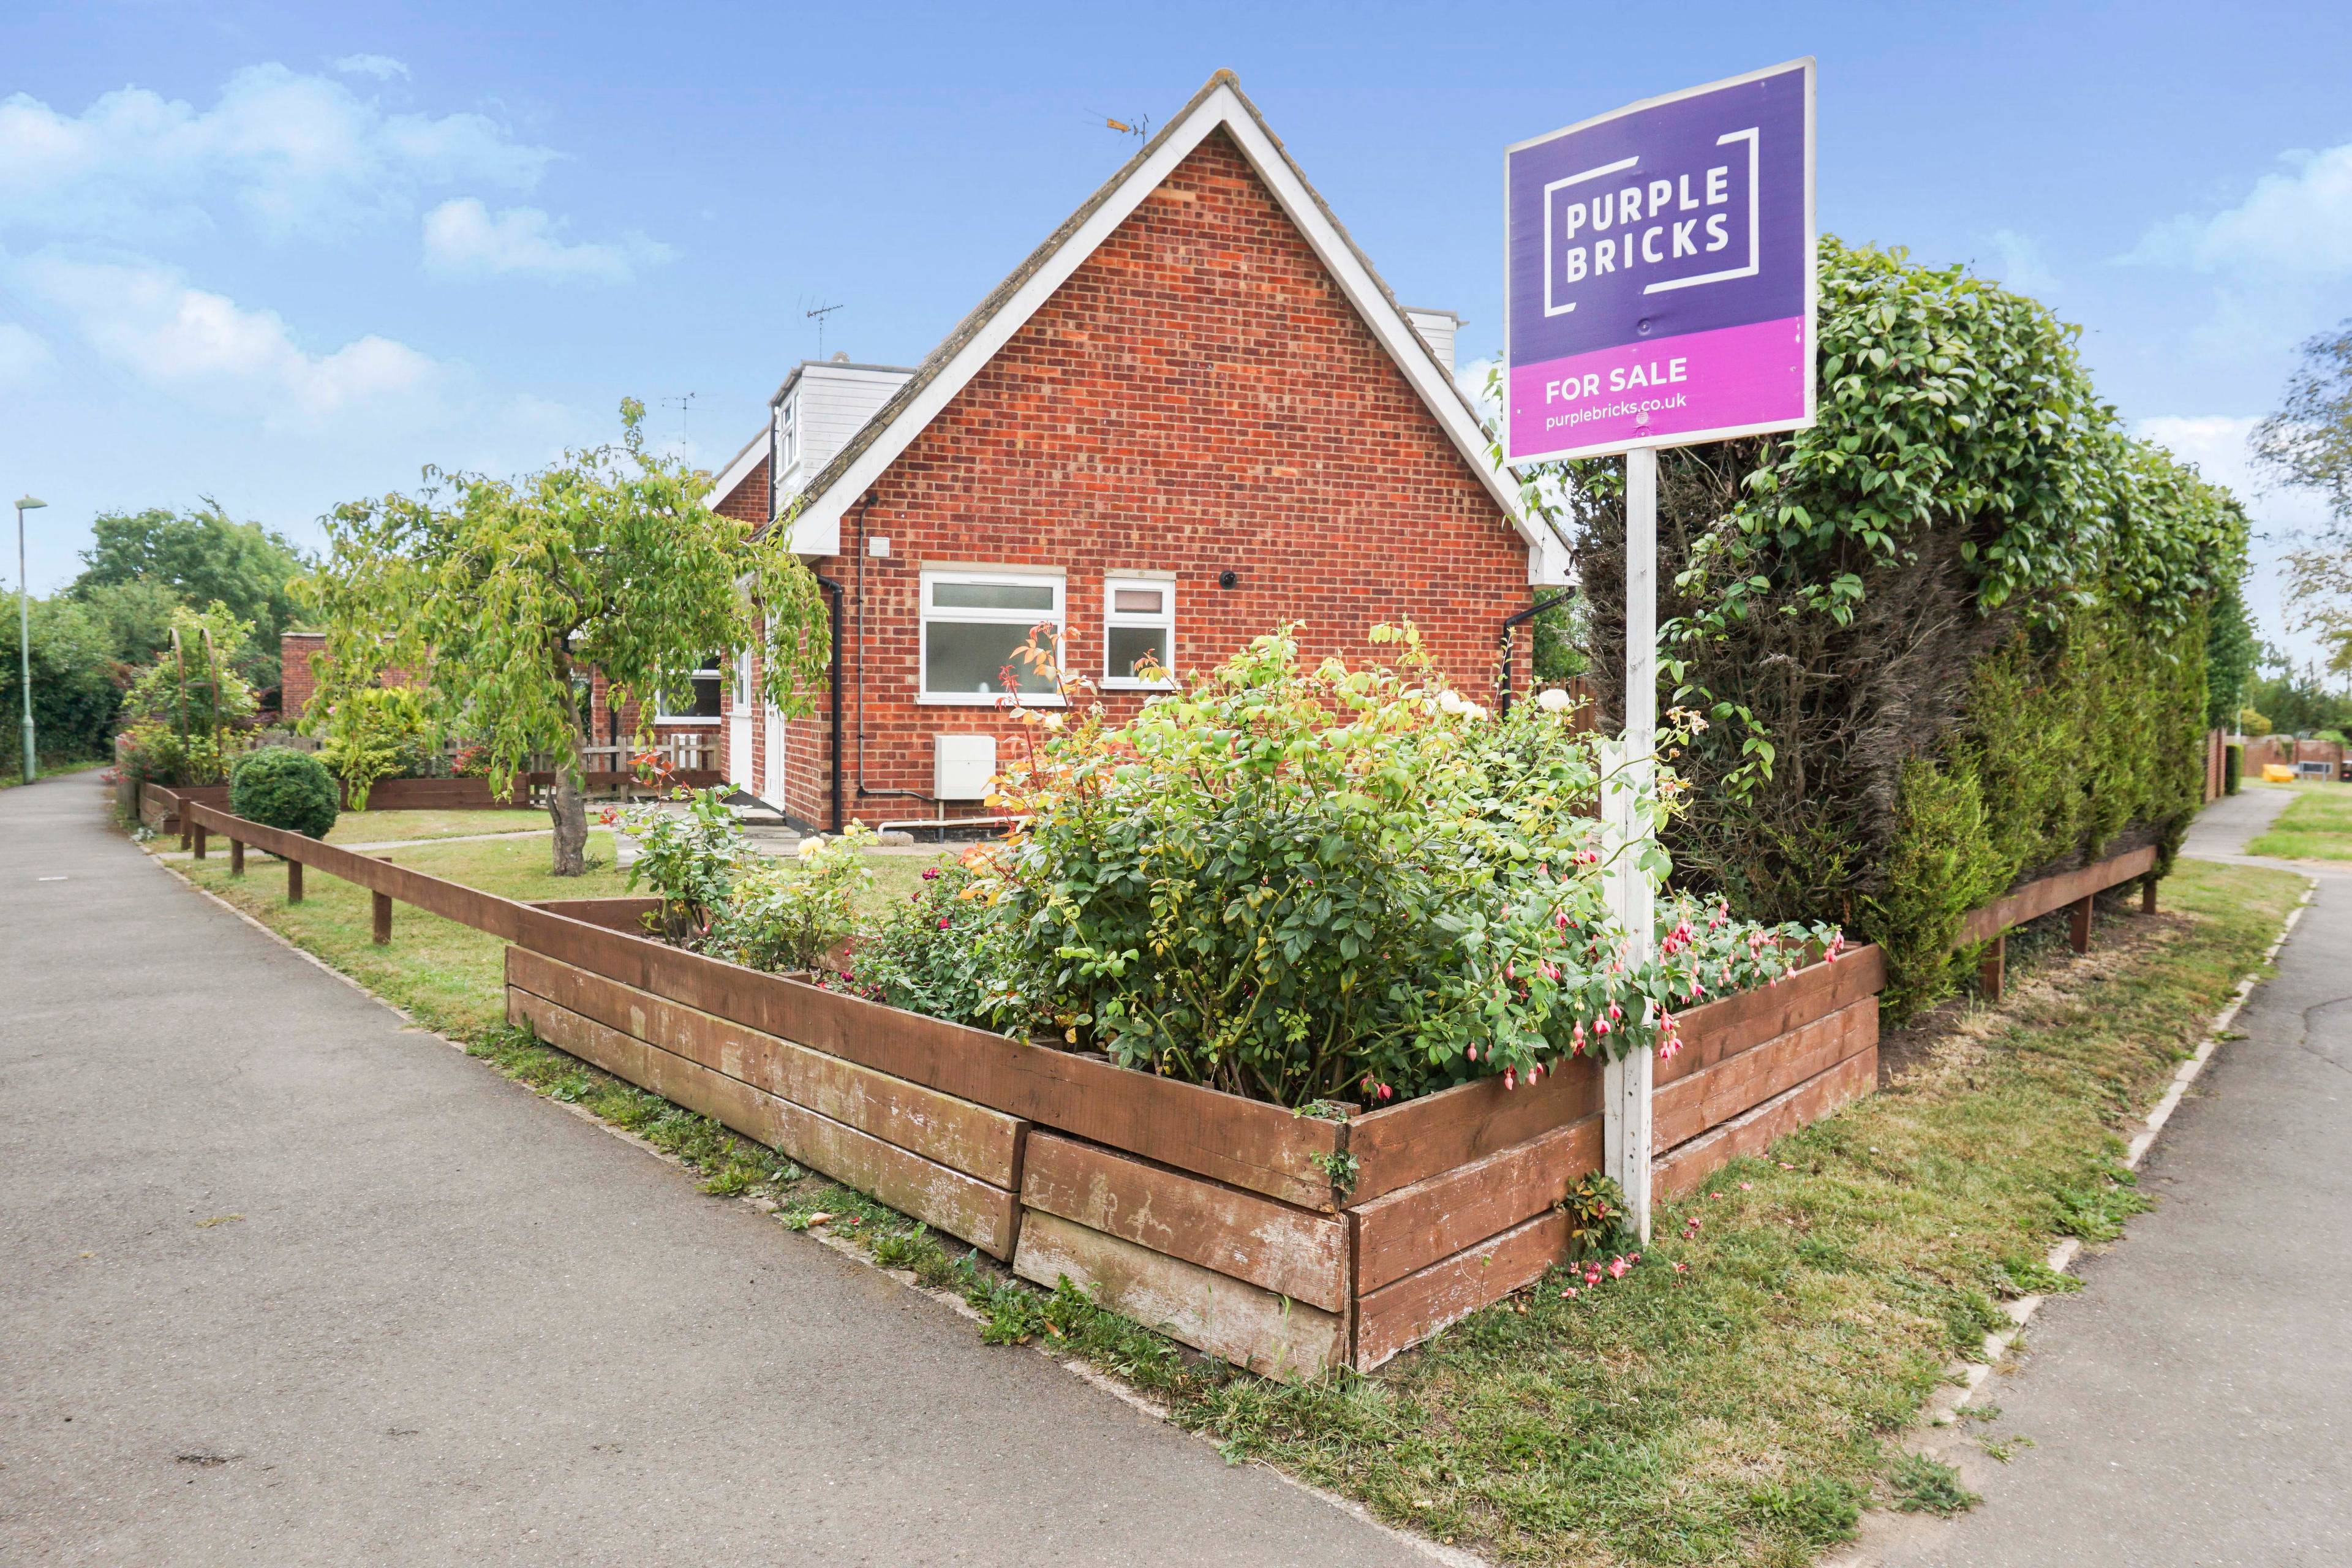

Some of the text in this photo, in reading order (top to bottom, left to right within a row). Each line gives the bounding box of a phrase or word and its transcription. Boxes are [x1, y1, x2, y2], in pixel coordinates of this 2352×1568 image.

[1567, 165, 1728, 239] PURPLE
[1567, 213, 1728, 283] BRICKS
[1546, 357, 1687, 404] FOR SALE
[1546, 392, 1687, 431] purplebricks.co.uk
